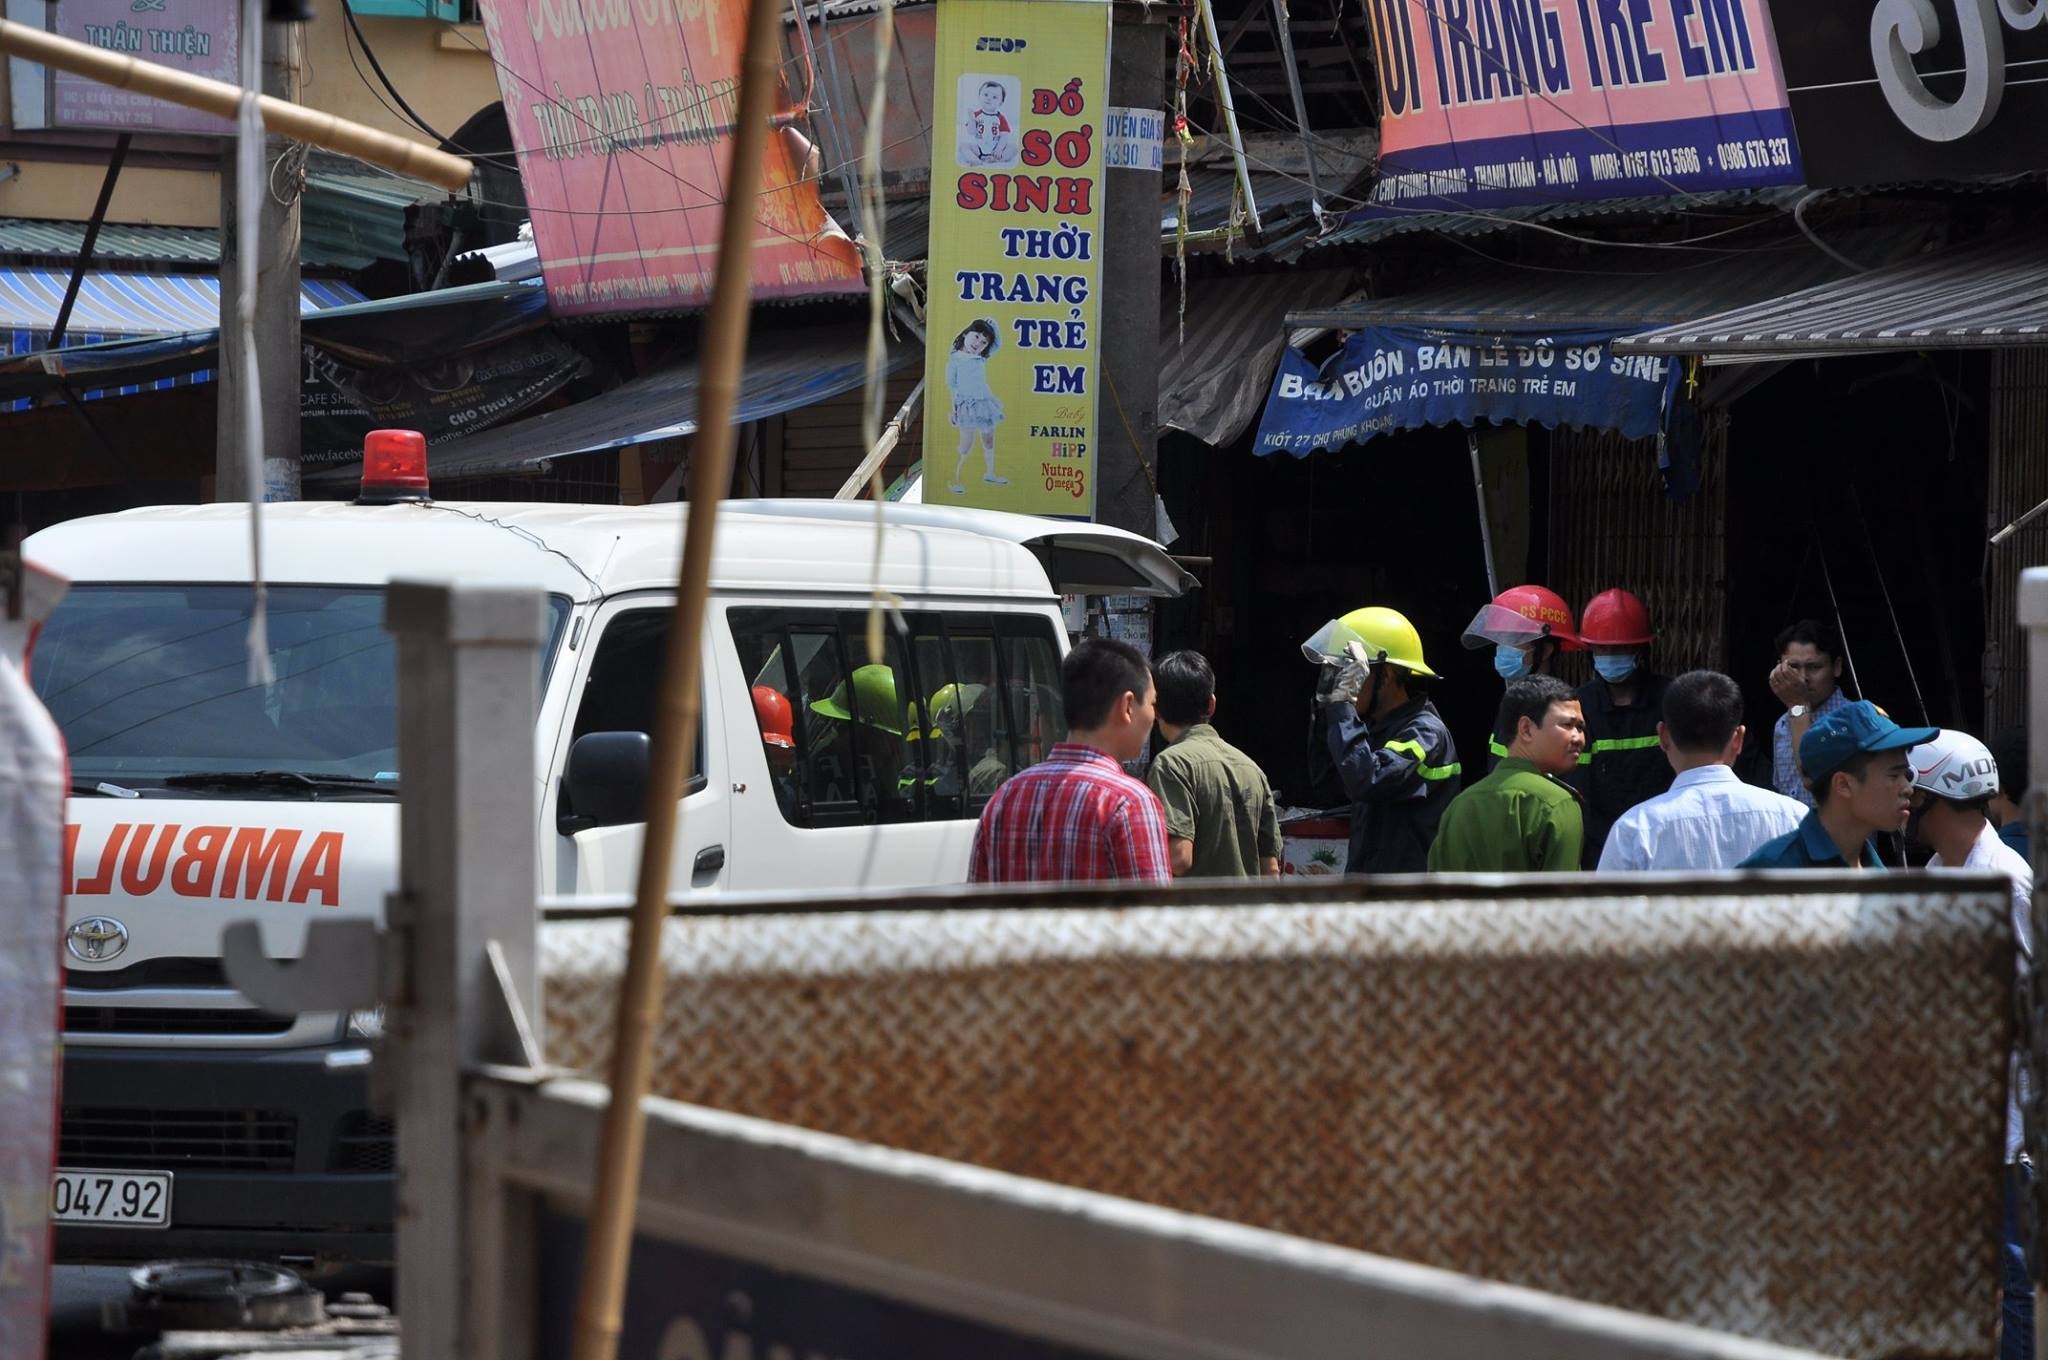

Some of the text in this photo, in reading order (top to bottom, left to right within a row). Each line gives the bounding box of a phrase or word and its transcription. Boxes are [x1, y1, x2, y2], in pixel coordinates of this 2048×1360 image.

[1671, 0, 1758, 83] EM
[576, 90, 646, 156] TRANG
[1021, 124, 1093, 168] SƠ
[1379, 174, 1397, 206] CHỢ
[1398, 168, 1428, 199] PHÙNG
[1429, 167, 1468, 195] KHOANG
[1474, 163, 1507, 190] THANH
[1507, 156, 1536, 189] XUÂN
[1542, 153, 1559, 185] HÀ
[1558, 151, 1579, 189] NỘI
[1590, 153, 1623, 181] MOBI:
[1650, 148, 1672, 177] 613
[1673, 146, 1701, 175] 5686
[1717, 142, 1747, 171] 0986
[1746, 139, 1770, 169] 676
[1768, 137, 1792, 166] 337
[956, 172, 1093, 215] SINH
[1001, 222, 1092, 261] THỜI
[956, 271, 1089, 304] TRANG
[1013, 308, 1088, 350] TRẺ
[1417, 339, 1471, 371] BÁN
[1515, 337, 1555, 368] ĐỒ
[1565, 345, 1603, 372] SƠ
[1033, 364, 1087, 395] EM
[1409, 380, 1428, 400] ÁO
[1433, 375, 1464, 396] THỜI
[1470, 378, 1517, 394] TRANG
[1522, 374, 1549, 394] TRẺ
[1553, 380, 1576, 397] EM
[449, 409, 478, 427] CHO
[1030, 425, 1085, 438] FARLIN
[1055, 407, 1086, 424] Baby
[1264, 414, 1394, 447] KIỐT 27 CHỢ PHÙNG KHOANG
[1041, 462, 1073, 477] Nutra
[1045, 470, 1084, 498] Omega 3
[1540, 607, 1568, 624] PCCC
[54, 1177, 162, 1219] 047.92
